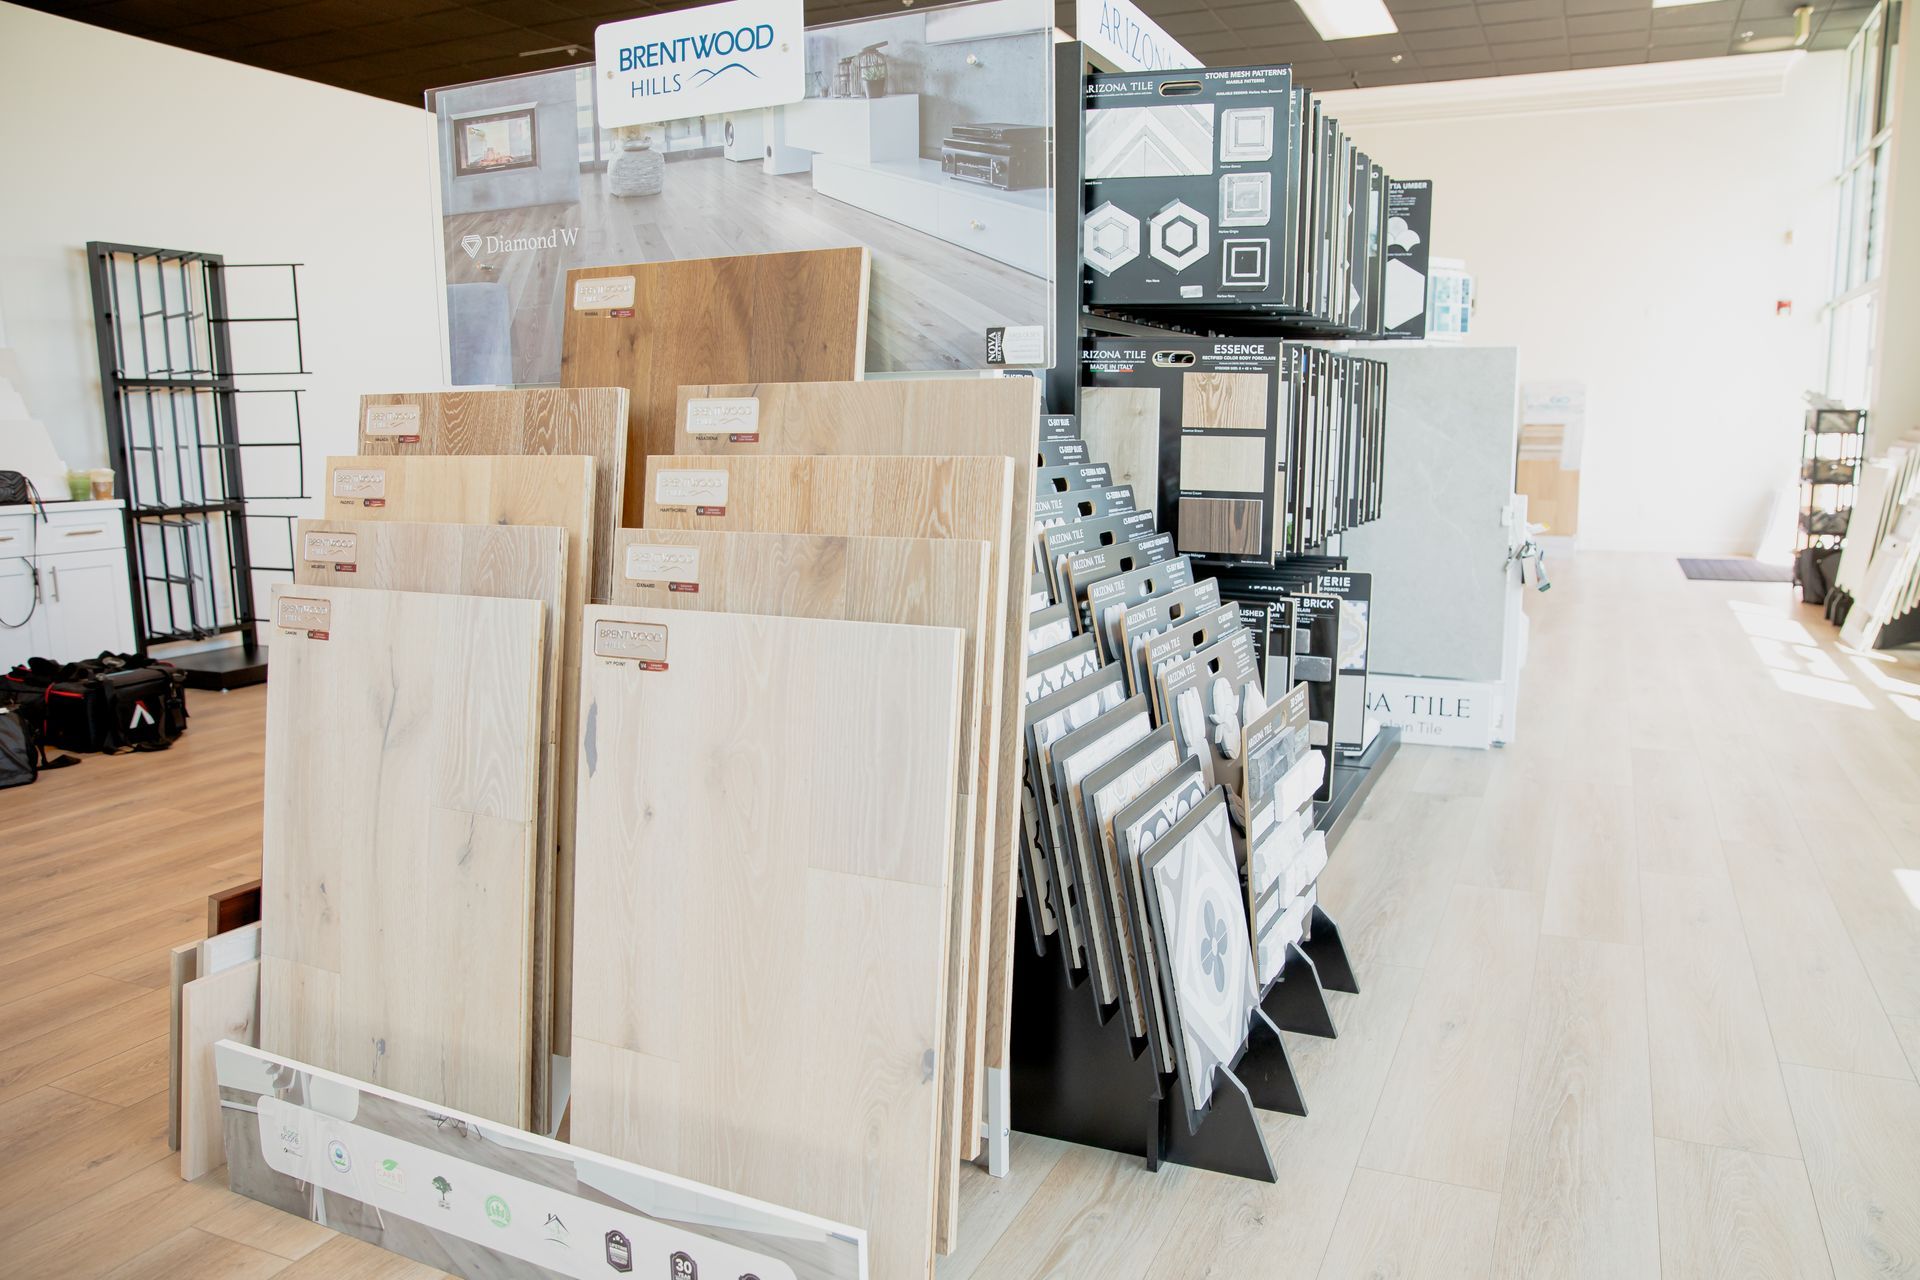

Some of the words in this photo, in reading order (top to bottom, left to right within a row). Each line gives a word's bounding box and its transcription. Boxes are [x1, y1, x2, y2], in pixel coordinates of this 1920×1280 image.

[619, 24, 774, 72] BRENTWOOD
[1204, 72, 1229, 80] STONE
[1230, 70, 1251, 78] MESH
[1252, 68, 1287, 76] PATTERNS
[632, 74, 682, 98] HILLS
[1130, 81, 1154, 91] TILE
[486, 228, 558, 254] Diamond
[560, 228, 579, 247] W
[988, 332, 996, 362] NOVA
[1082, 350, 1121, 359] RIZONA
[1124, 350, 1146, 359] TILE
[1214, 344, 1265, 354] ESSENCE
[1036, 501, 1051, 512] ZONA
[1052, 500, 1062, 509] TILE
[1050, 532, 1072, 545] ARIZONA
[1072, 529, 1084, 539] TILE
[1073, 556, 1094, 570] ARIZONA
[1094, 554, 1106, 564] TILE
[1094, 584, 1114, 598] ARIZONA
[1114, 580, 1125, 590] TILE
[1303, 598, 1334, 609] BRICK
[1127, 610, 1146, 626] ARIZONA
[1147, 606, 1157, 617] TILE
[1240, 609, 1264, 617] LISHED
[600, 628, 663, 642] BRENTWOOD
[1152, 642, 1171, 658] ARIZONA
[1171, 637, 1181, 648] TILE
[1167, 668, 1186, 685] ARIZONA
[1186, 662, 1195, 674] TILE
[1404, 694, 1470, 718] TILE
[1248, 729, 1264, 750] ARIZONA
[1264, 722, 1272, 736] TILE
[1418, 722, 1442, 736] Tile
[676, 1258, 692, 1274] 30
